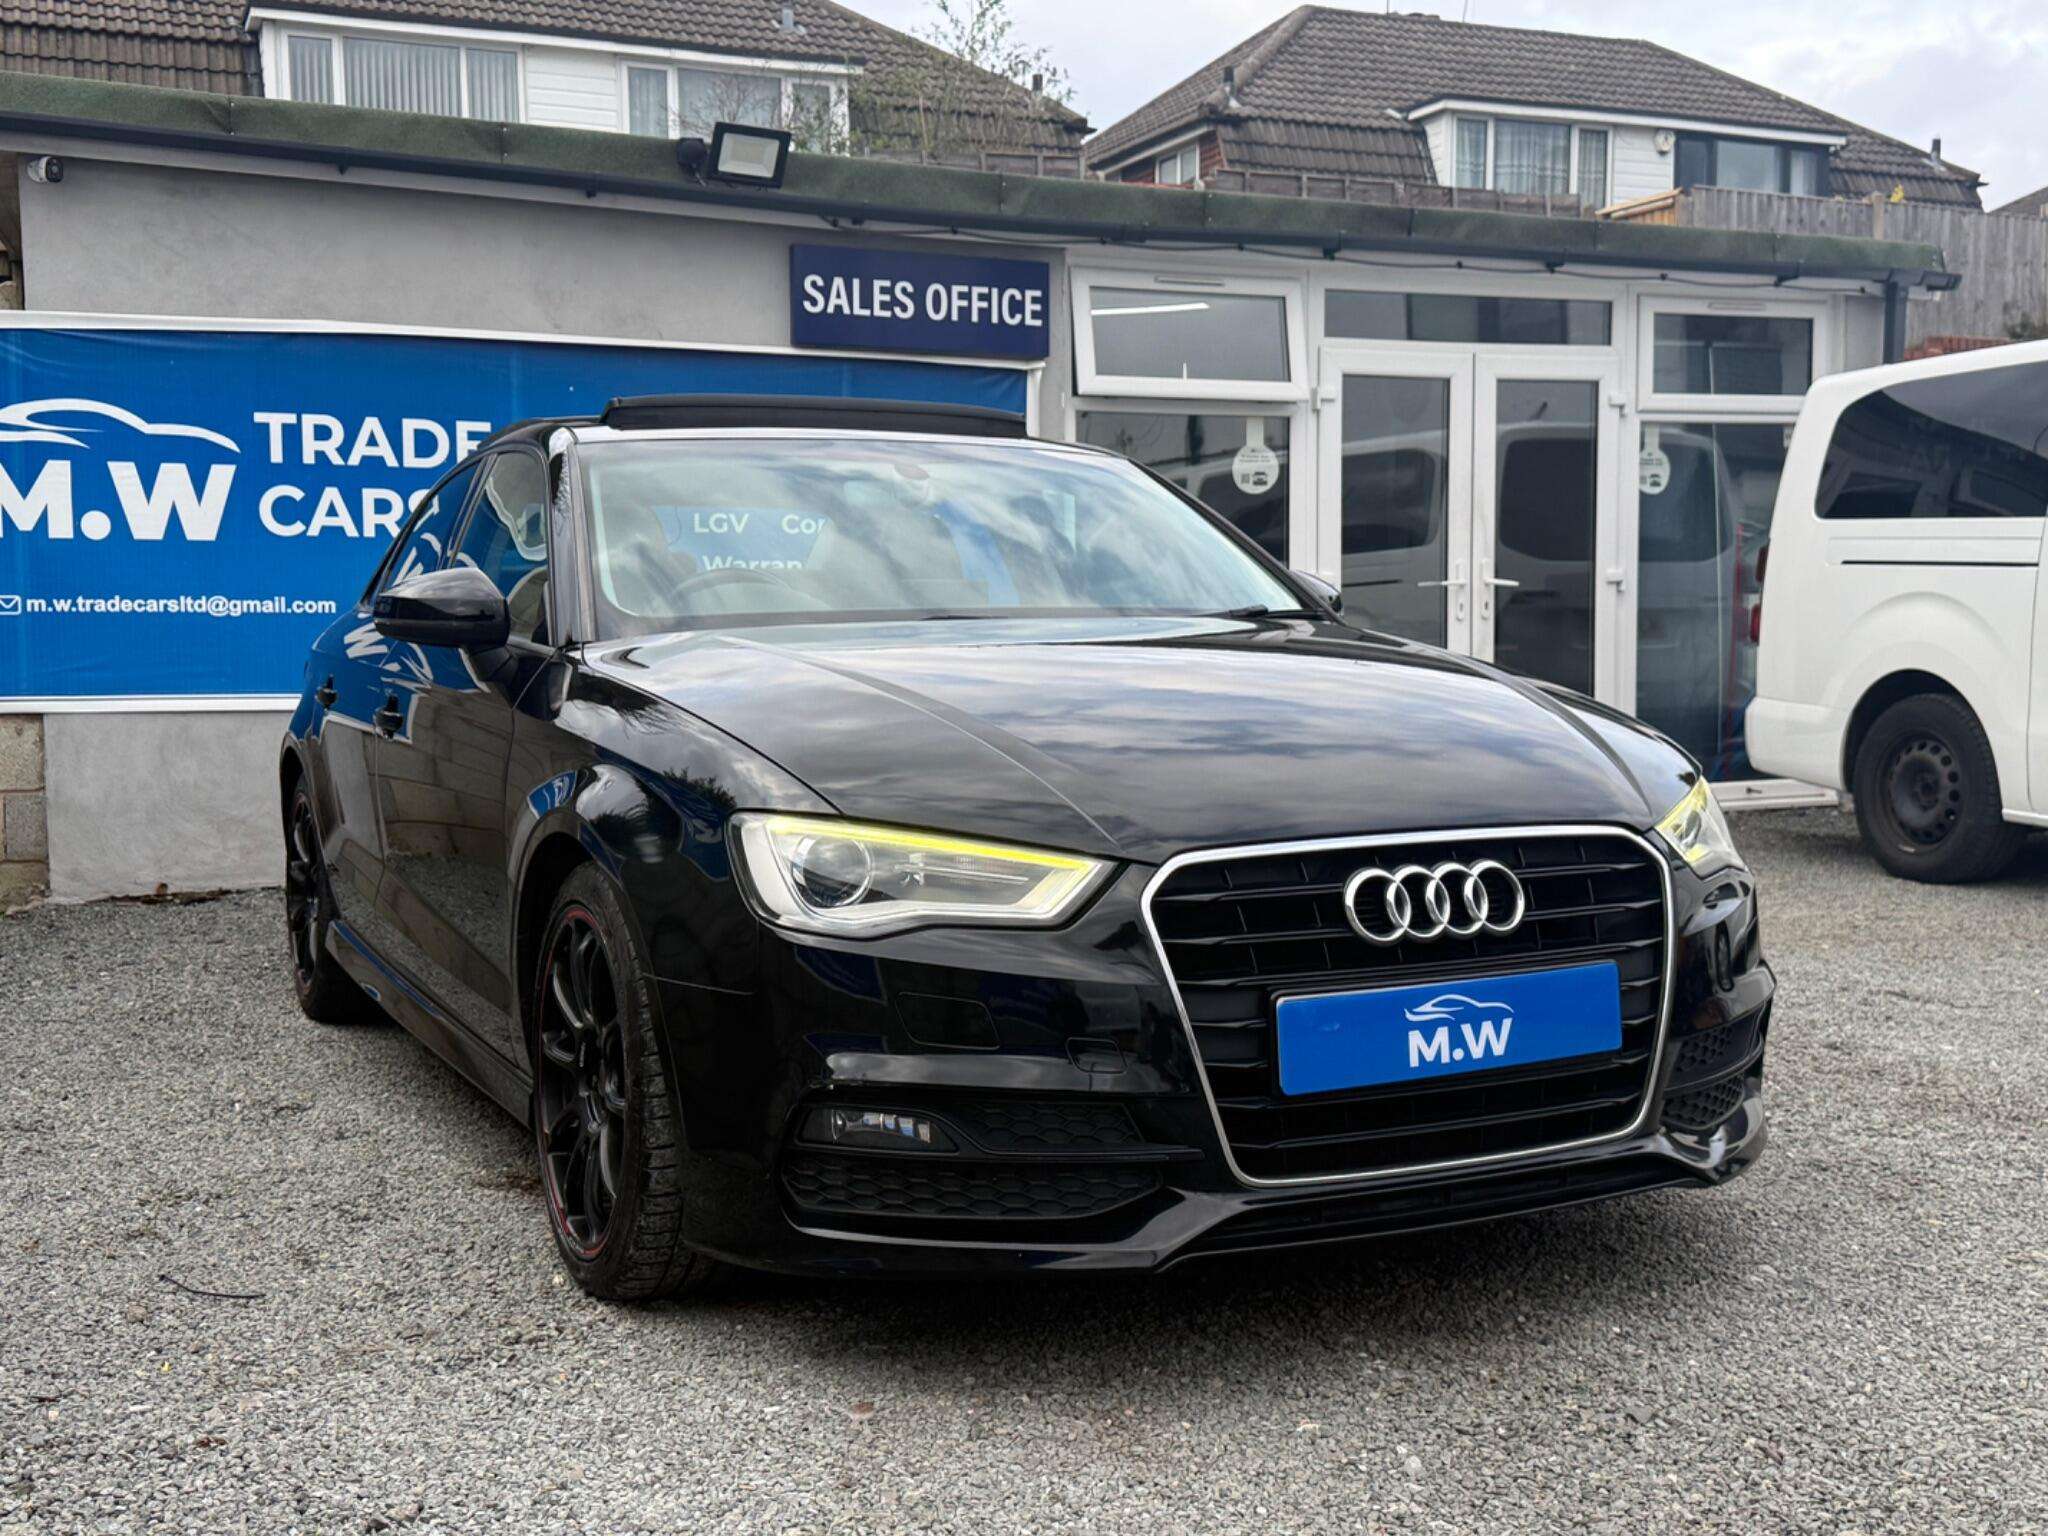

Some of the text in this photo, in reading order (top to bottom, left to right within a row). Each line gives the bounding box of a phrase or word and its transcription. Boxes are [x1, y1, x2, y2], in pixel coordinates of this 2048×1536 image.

[802, 273, 1043, 327] SALES OFFICE
[0, 459, 237, 542] M.W
[693, 512, 750, 534] LGV
[26, 595, 337, 617] m.w.tradecarsltd@gmail.com
[1408, 1017, 1513, 1068] M.W
